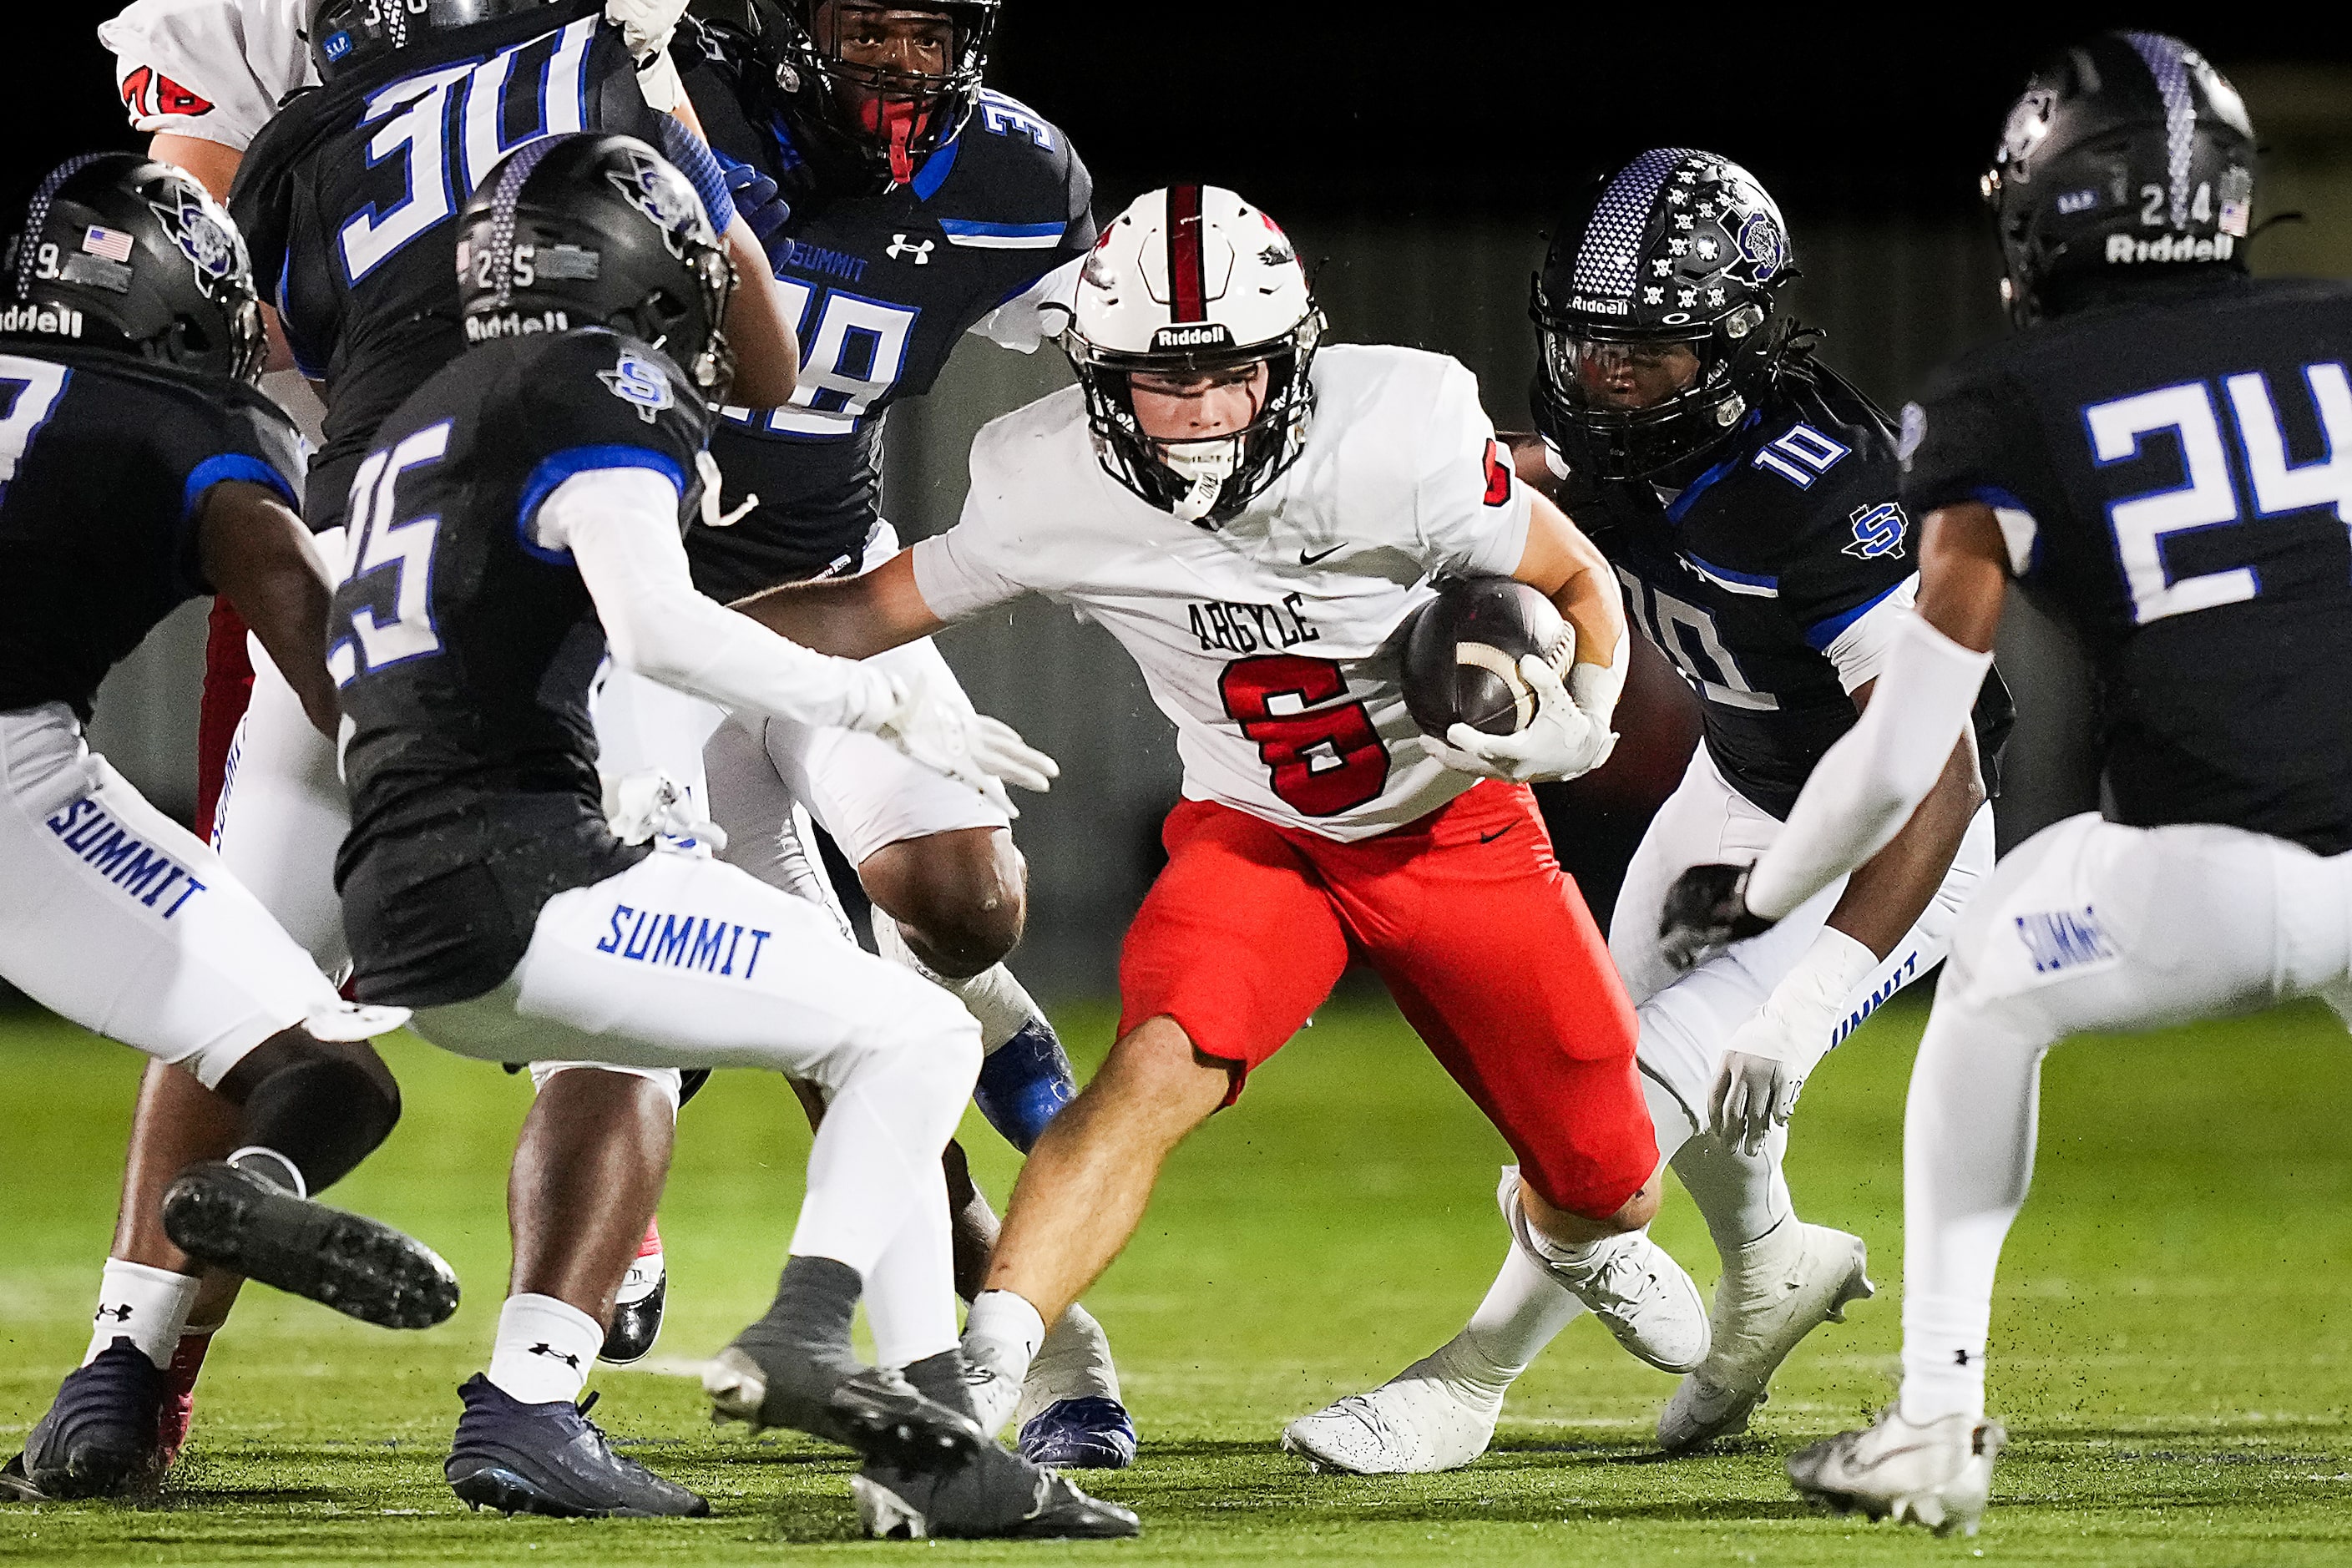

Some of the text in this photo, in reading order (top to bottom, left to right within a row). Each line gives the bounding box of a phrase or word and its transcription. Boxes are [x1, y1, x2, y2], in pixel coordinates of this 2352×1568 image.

[336, 13, 601, 290] 30
[35, 243, 59, 279] 9
[788, 241, 868, 282] SUMMIT
[2105, 232, 2234, 264] Riddell
[0, 304, 83, 339] ddell
[466, 310, 569, 343] Riddell
[1571, 295, 1628, 316] Riddell
[1157, 326, 1225, 346] Riddell
[1750, 421, 1853, 492] 10
[2081, 362, 2352, 625] 24
[1851, 503, 1904, 558] S
[1187, 591, 1321, 653] ARGYLE
[1216, 653, 1393, 817] 6
[47, 798, 207, 919] SUMMIT
[595, 903, 772, 979] SUMMIT
[1819, 949, 1918, 1058] UMMIT
